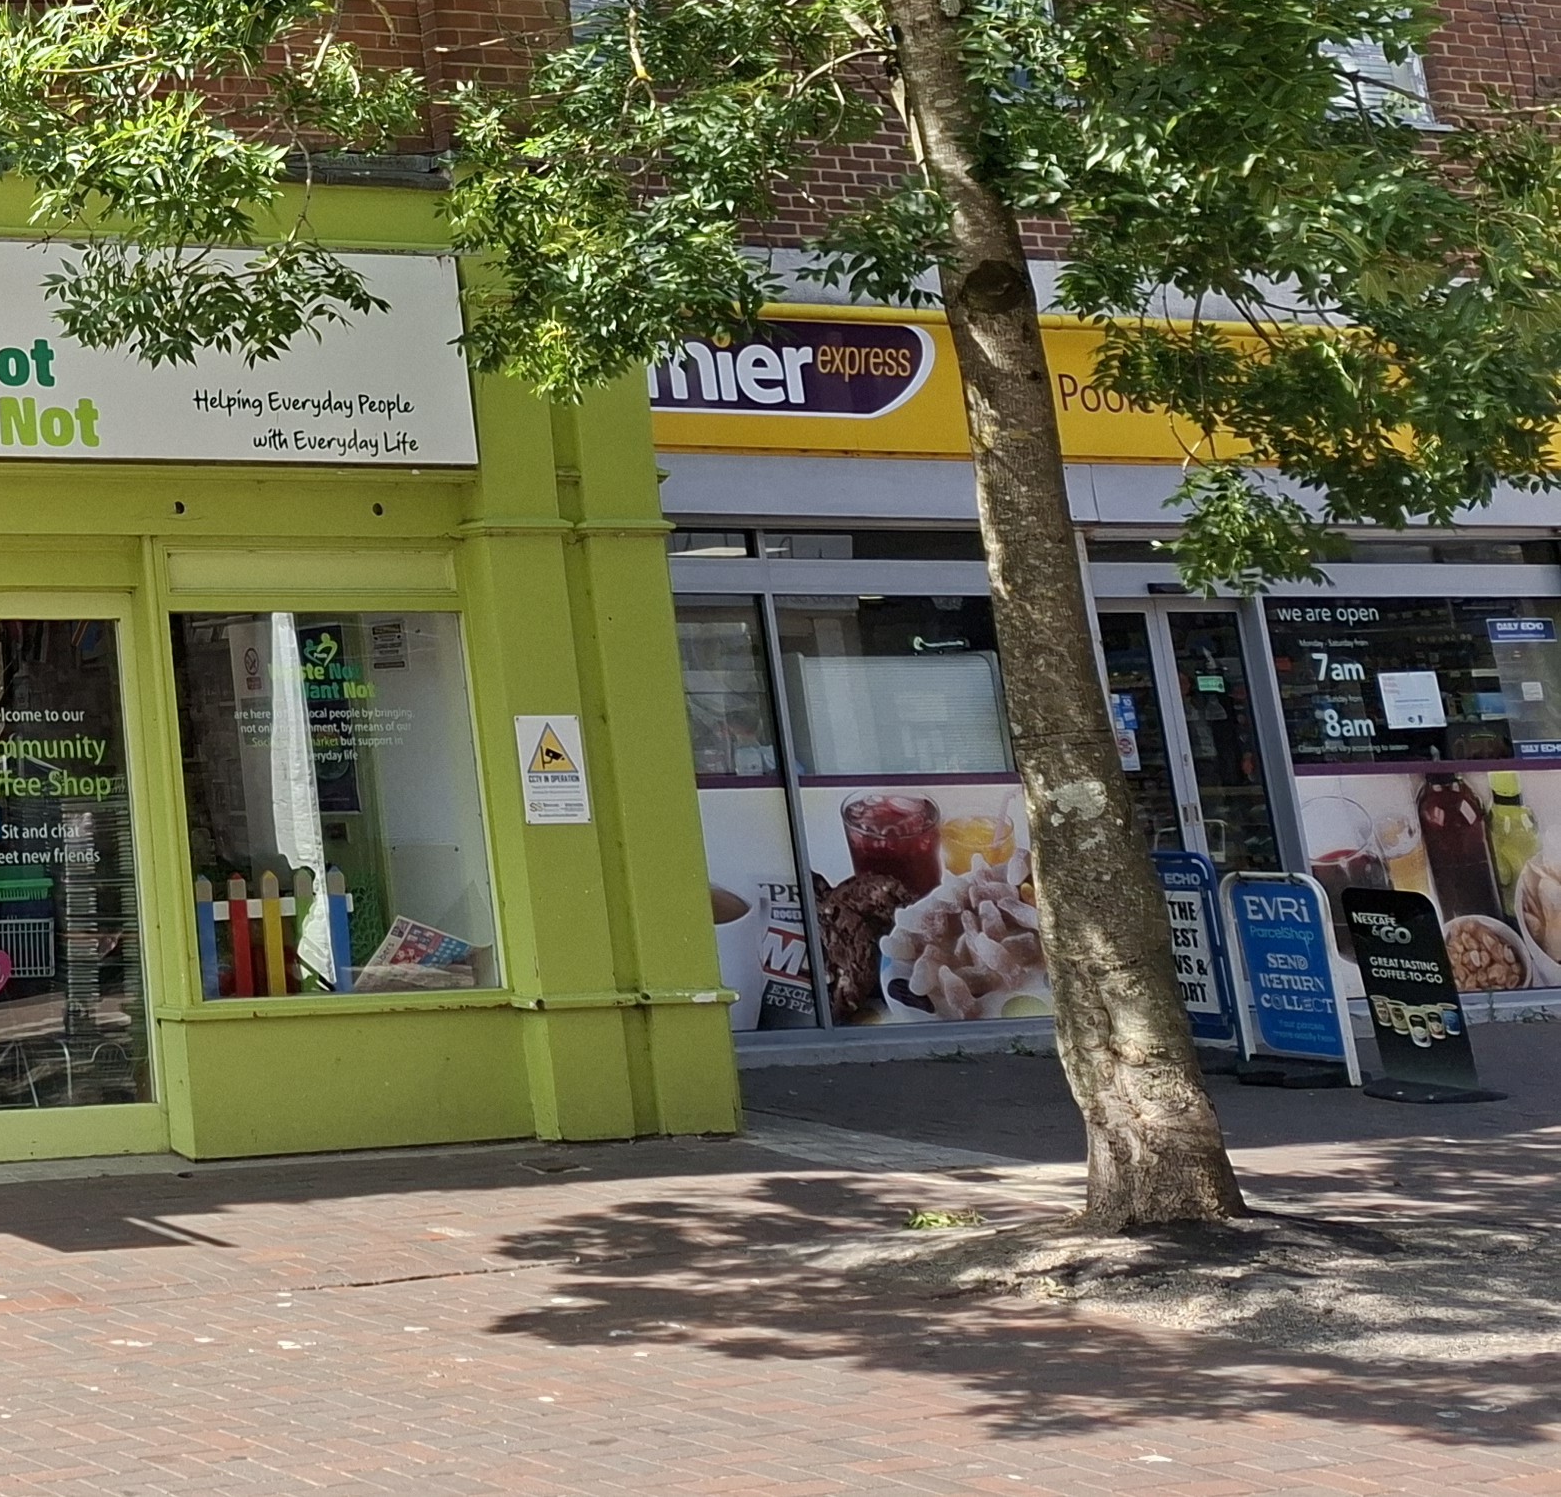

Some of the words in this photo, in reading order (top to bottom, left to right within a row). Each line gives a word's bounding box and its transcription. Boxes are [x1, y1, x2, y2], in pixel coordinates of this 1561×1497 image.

[817, 345, 911, 382] express
[193, 388, 263, 417] Helping
[268, 390, 353, 418] Everyday
[358, 393, 415, 421] People
[0, 397, 100, 447] Not
[253, 428, 288, 450] with
[293, 428, 378, 457] Everyday
[383, 430, 419, 455] Life
[1277, 608, 1301, 621] we
[1305, 607, 1331, 621] are
[1336, 606, 1379, 626] open
[1312, 653, 1365, 681] 7am
[343, 682, 376, 699] Not
[45, 709, 58, 721] to
[62, 710, 85, 721] our
[250, 708, 271, 720] here
[308, 707, 327, 719] ocal
[329, 708, 360, 722] people
[362, 708, 373, 722] by
[1324, 708, 1376, 737] 8am
[240, 725, 256, 734] not
[258, 723, 277, 734] onl
[341, 723, 353, 737] by
[355, 724, 384, 733] means
[386, 721, 396, 732] of
[340, 733, 356, 746] but
[358, 735, 393, 749] support
[344, 749, 358, 761] life
[48, 770, 111, 802] Shop
[1, 823, 19, 839] Sit
[22, 823, 47, 839] and
[51, 822, 80, 838] chat
[22, 852, 50, 863] new
[54, 847, 101, 863] friends
[1165, 873, 1201, 885] ECHO
[1168, 901, 1197, 921] THE
[1250, 925, 1315, 945] ParcelShop
[1380, 926, 1412, 944] GO
[1197, 958, 1208, 976] &
[1266, 953, 1308, 970] SEND
[1370, 956, 1399, 969] GREAT
[1400, 959, 1439, 972] TASTING
[1260, 974, 1326, 992] RETURN
[1372, 968, 1443, 984] COFFEE-TO-GO
[766, 995, 787, 1008] TO
[770, 984, 814, 1004] EXCL
[1261, 993, 1335, 1014] COLLECT
